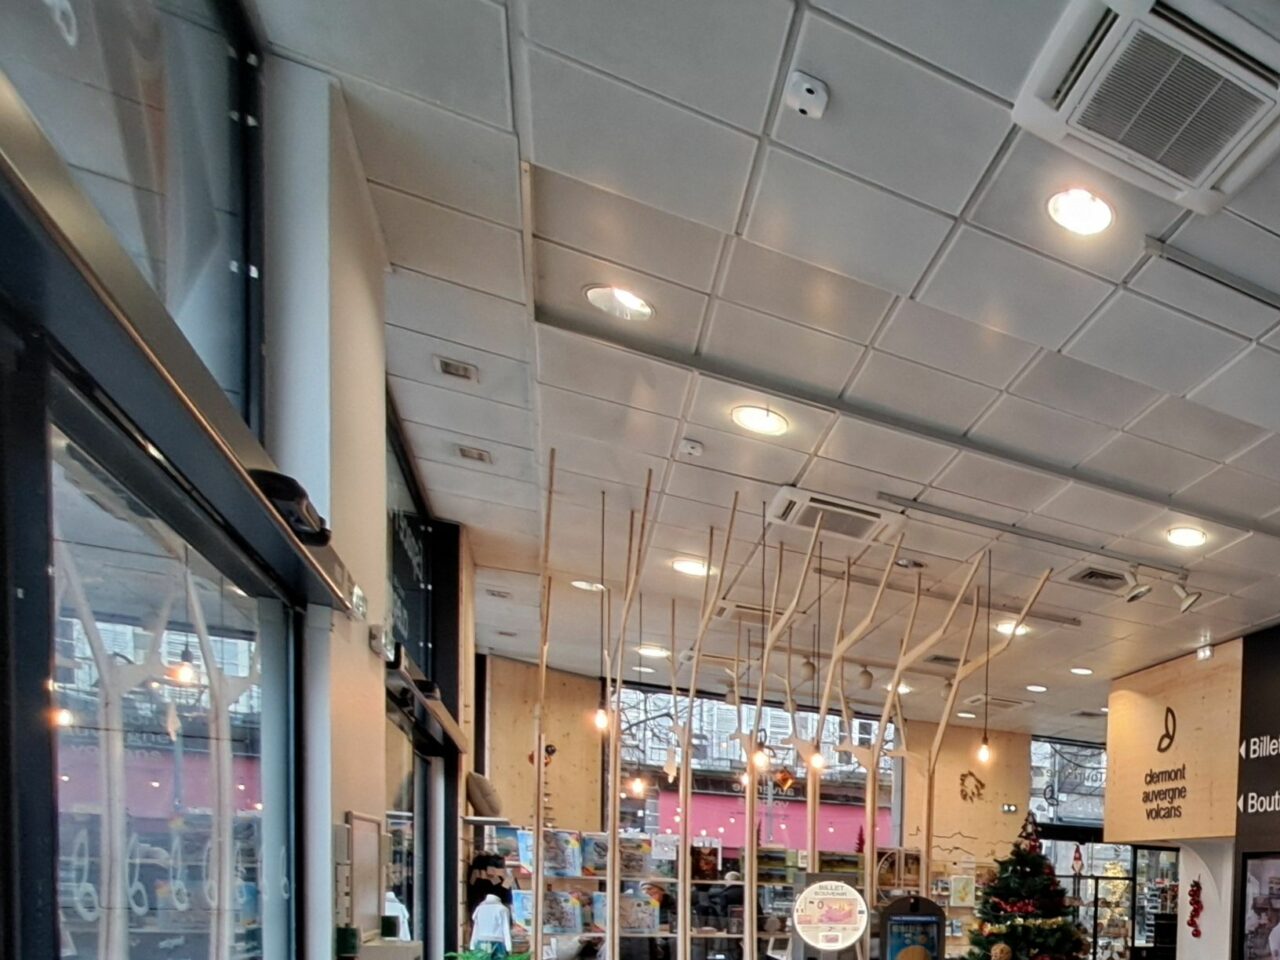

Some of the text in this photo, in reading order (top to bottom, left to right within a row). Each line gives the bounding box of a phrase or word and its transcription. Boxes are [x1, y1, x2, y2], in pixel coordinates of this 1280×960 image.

[1144, 763, 1186, 785] clermont
[1142, 786, 1187, 804] auvergne
[1145, 803, 1182, 820] volcans
